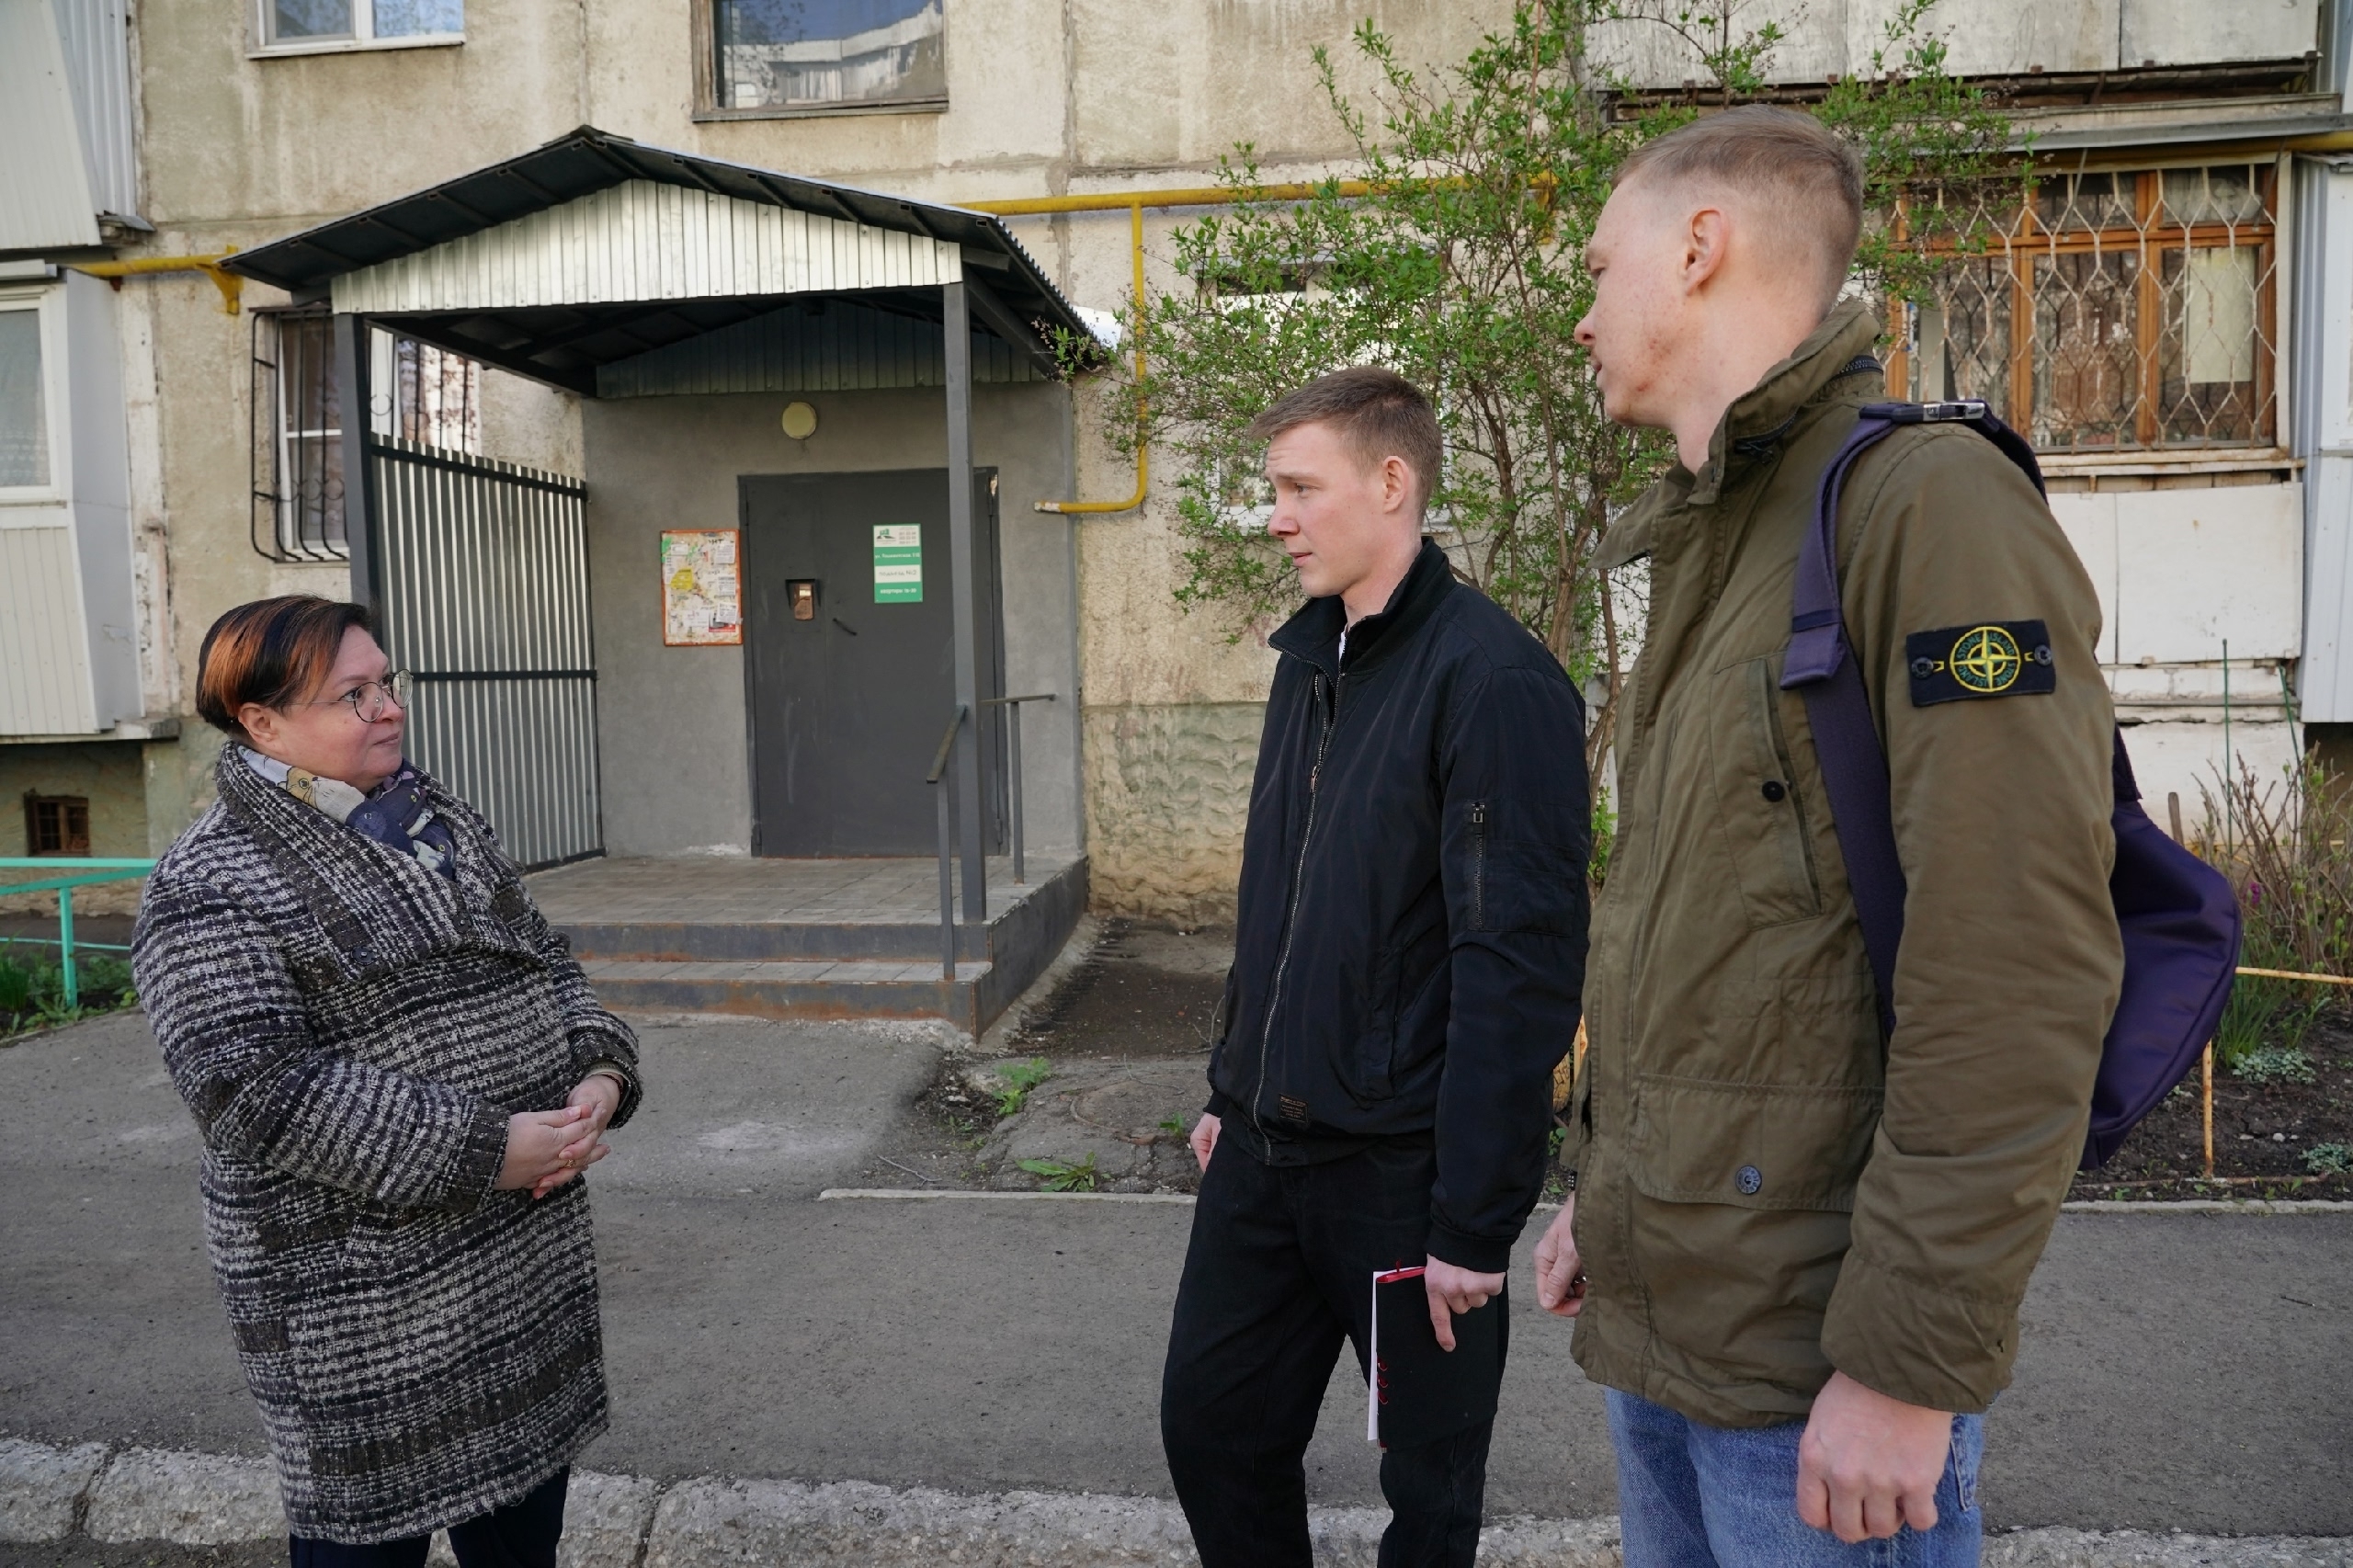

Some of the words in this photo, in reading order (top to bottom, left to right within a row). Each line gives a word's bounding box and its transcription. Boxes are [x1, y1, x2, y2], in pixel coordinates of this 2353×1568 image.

[1956, 632, 1982, 659] STONE
[1990, 631, 2015, 656] ISLAND
[1958, 665, 1987, 687] ISLAND
[1996, 662, 2017, 687] STONE
